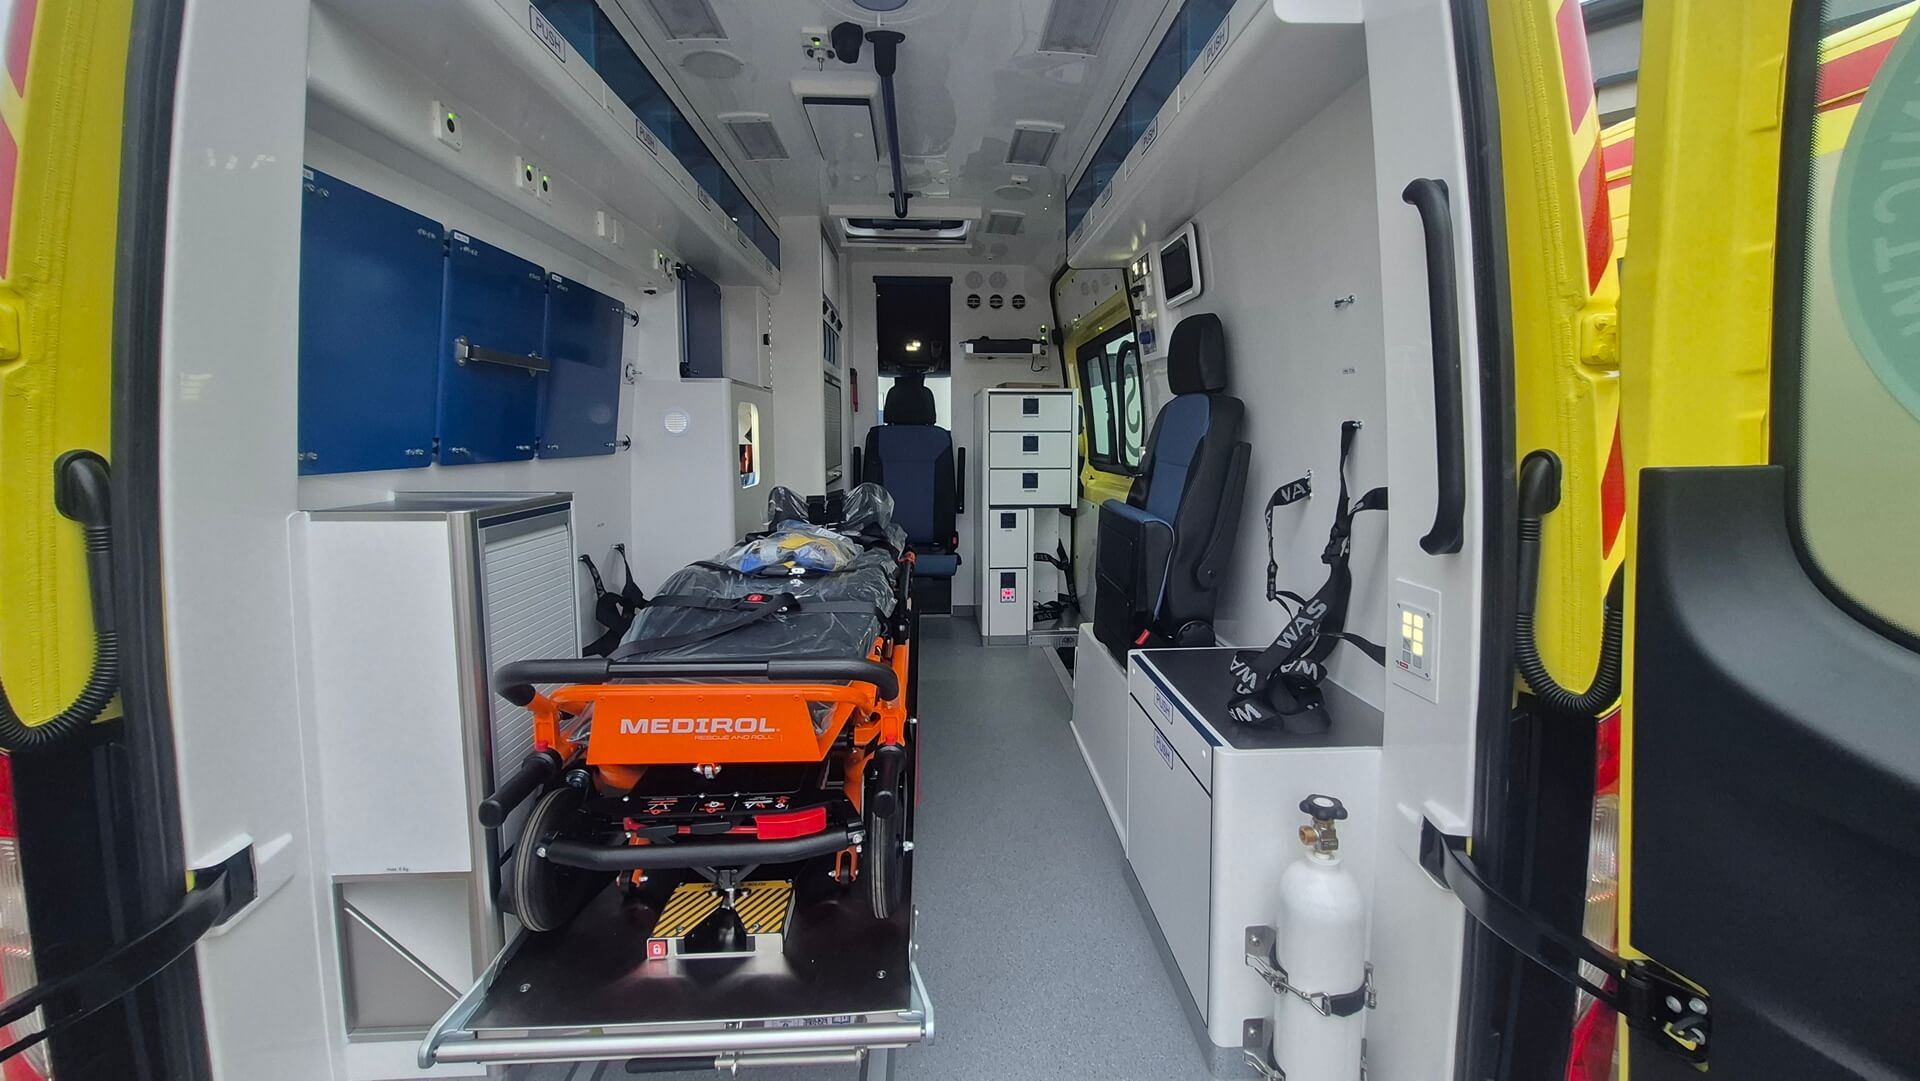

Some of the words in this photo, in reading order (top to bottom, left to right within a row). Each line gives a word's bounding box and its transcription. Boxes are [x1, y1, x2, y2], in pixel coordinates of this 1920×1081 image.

[535, 16, 561, 53] PUSH
[1206, 26, 1225, 64] PUSH
[640, 125, 655, 149] PUSH
[1277, 599, 1327, 649] WAS
[1156, 692, 1170, 717] PUSH
[620, 717, 776, 734] MEDIROL
[1156, 734, 1170, 762] PUSH
